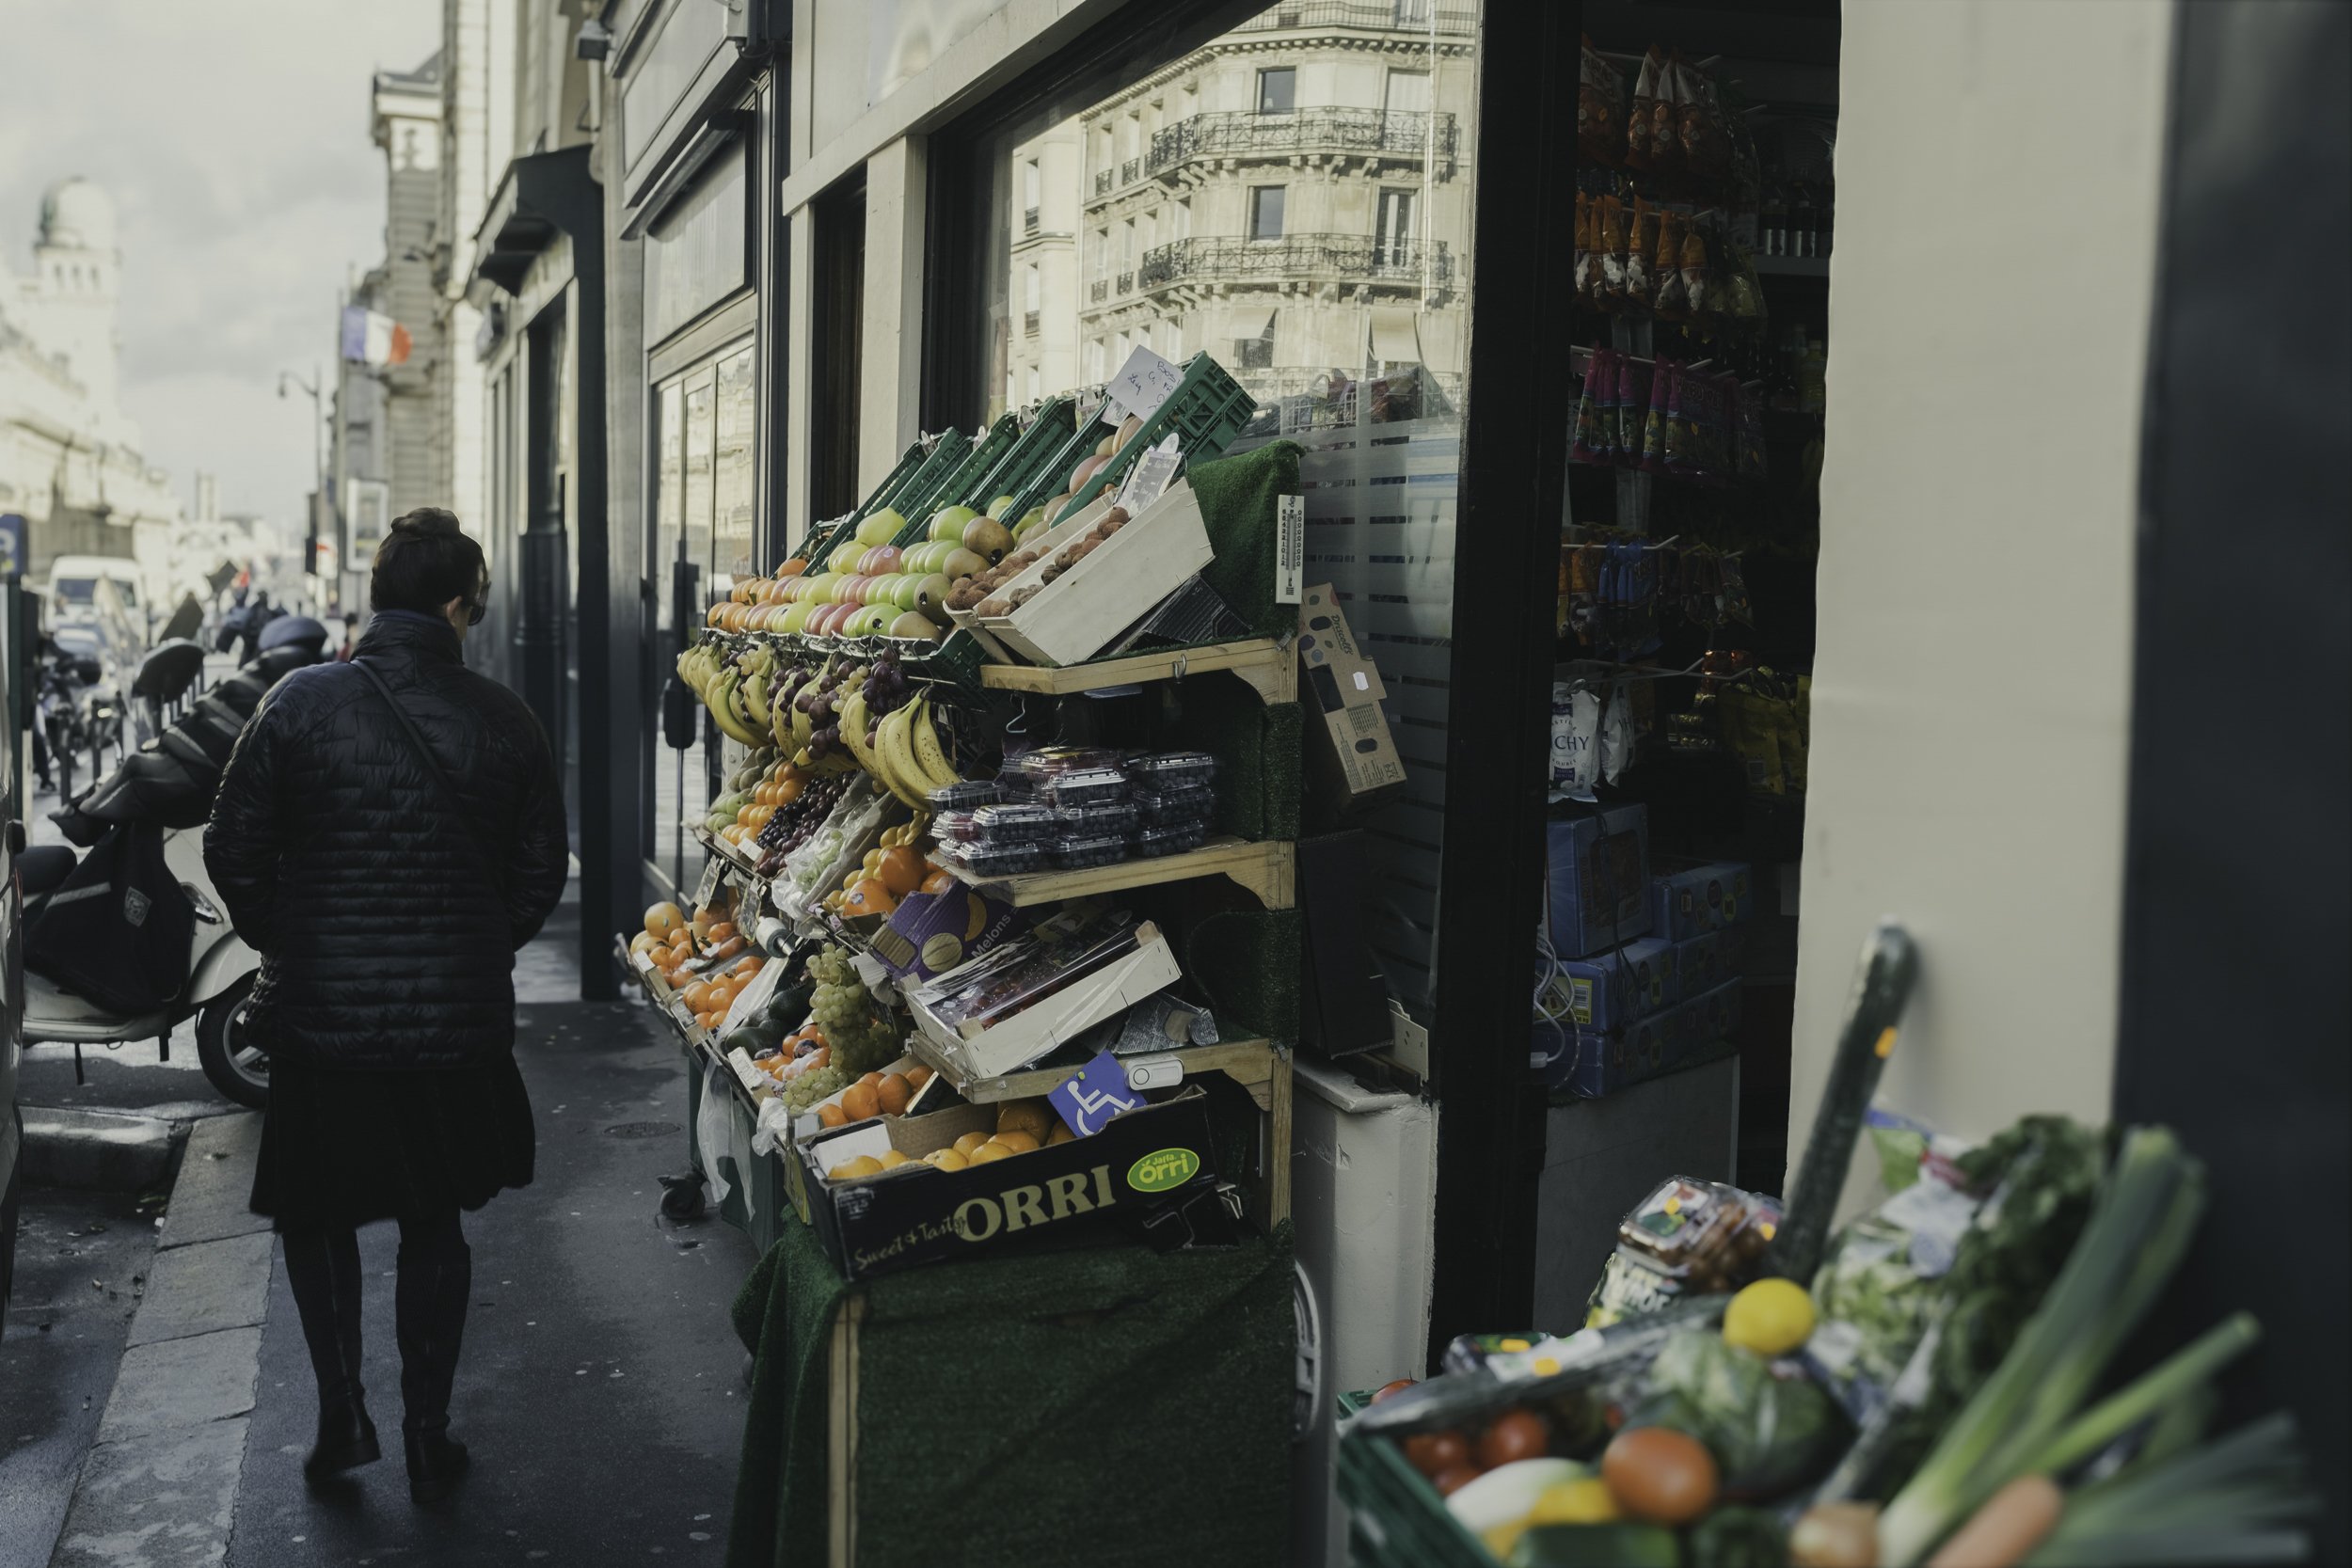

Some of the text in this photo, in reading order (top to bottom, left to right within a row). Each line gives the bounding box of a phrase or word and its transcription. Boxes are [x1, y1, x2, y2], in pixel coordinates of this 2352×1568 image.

[1552, 736, 1589, 750] CHY
[970, 913, 1012, 959] Melons
[953, 1164, 1117, 1243] ORRI
[853, 1236, 905, 1272] Sweet
[918, 1216, 966, 1242] Tasty
